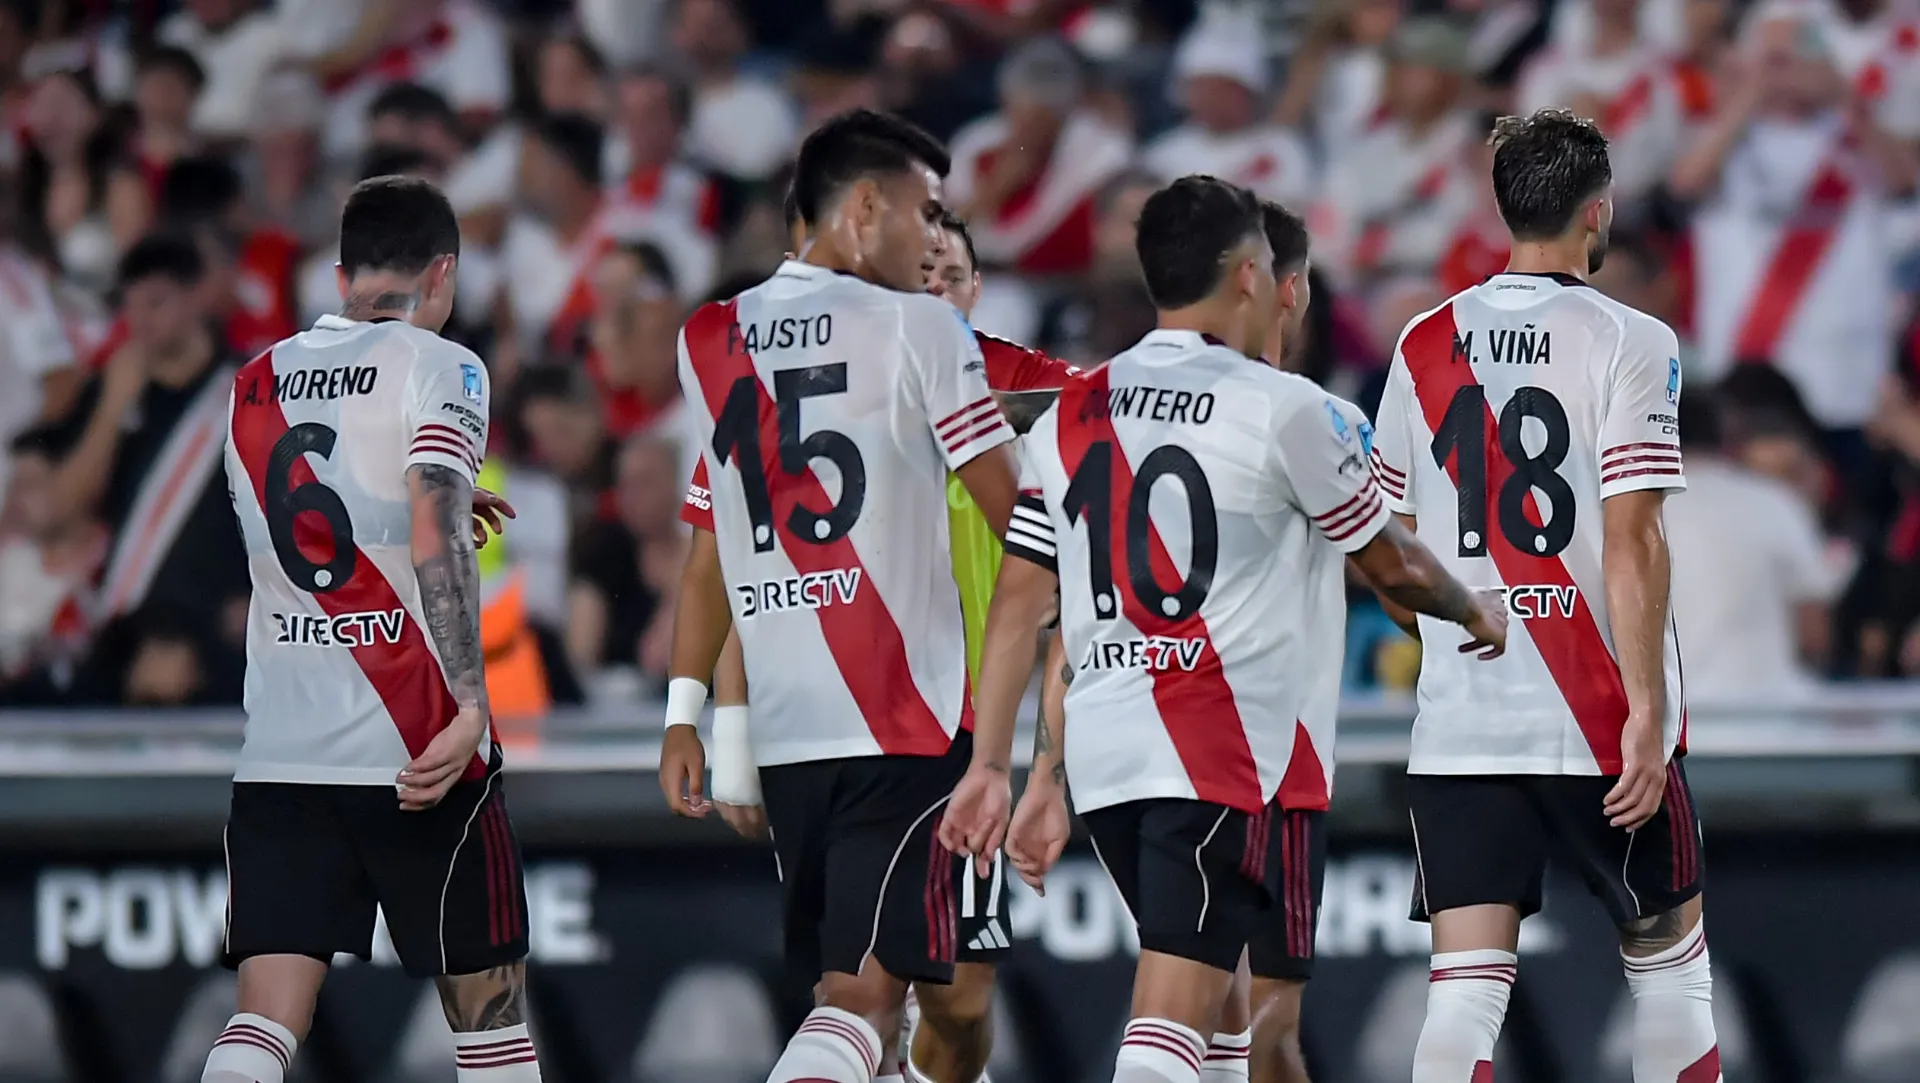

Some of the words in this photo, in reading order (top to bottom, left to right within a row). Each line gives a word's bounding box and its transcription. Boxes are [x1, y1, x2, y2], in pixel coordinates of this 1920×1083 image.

[728, 314, 832, 356] FAUSTO
[1451, 330, 1478, 364] M.
[1489, 323, 1551, 365] VIÑA
[269, 366, 378, 403] MORENO
[1079, 386, 1215, 425] INTERO
[712, 362, 866, 552] 15
[1431, 383, 1576, 557] 18
[265, 422, 356, 593] 6
[1063, 441, 1218, 621] 10
[737, 569, 860, 618] DIRECTV
